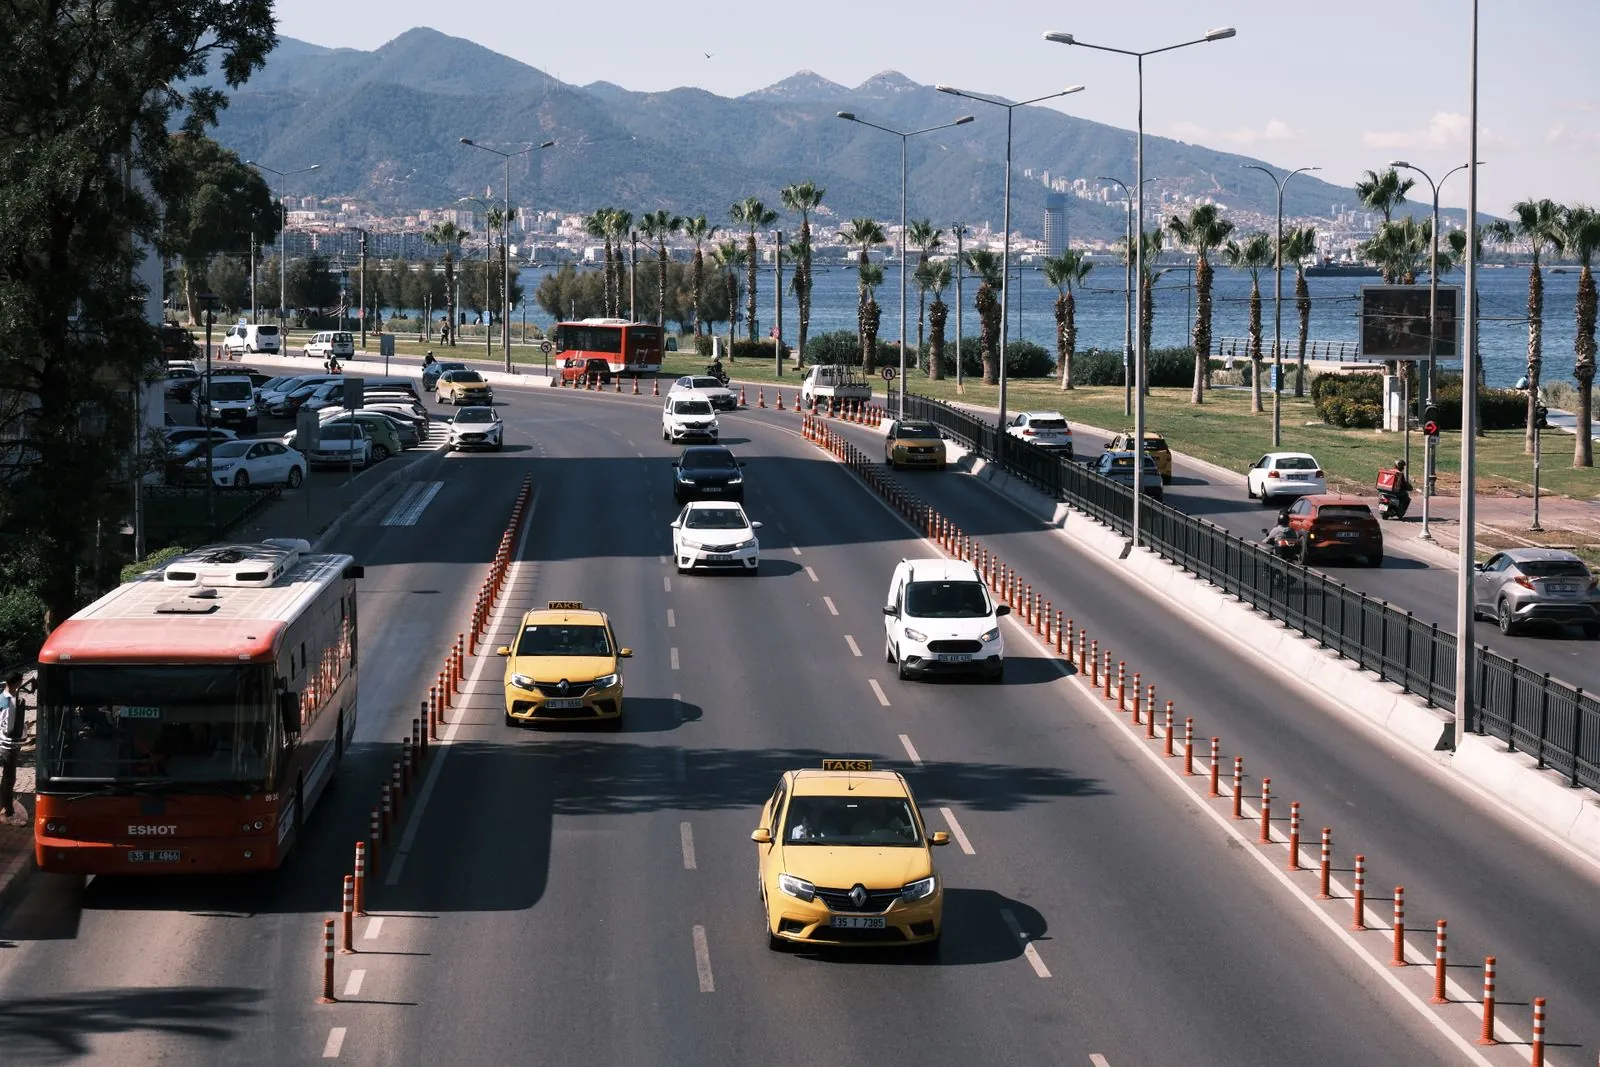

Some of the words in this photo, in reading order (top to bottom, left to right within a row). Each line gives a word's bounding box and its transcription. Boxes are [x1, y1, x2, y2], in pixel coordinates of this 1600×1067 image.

[129, 707, 159, 717] ESHOT
[127, 825, 178, 836] ESHOT
[134, 852, 145, 861] 35
[837, 917, 848, 927] 35
[852, 918, 858, 927] T
